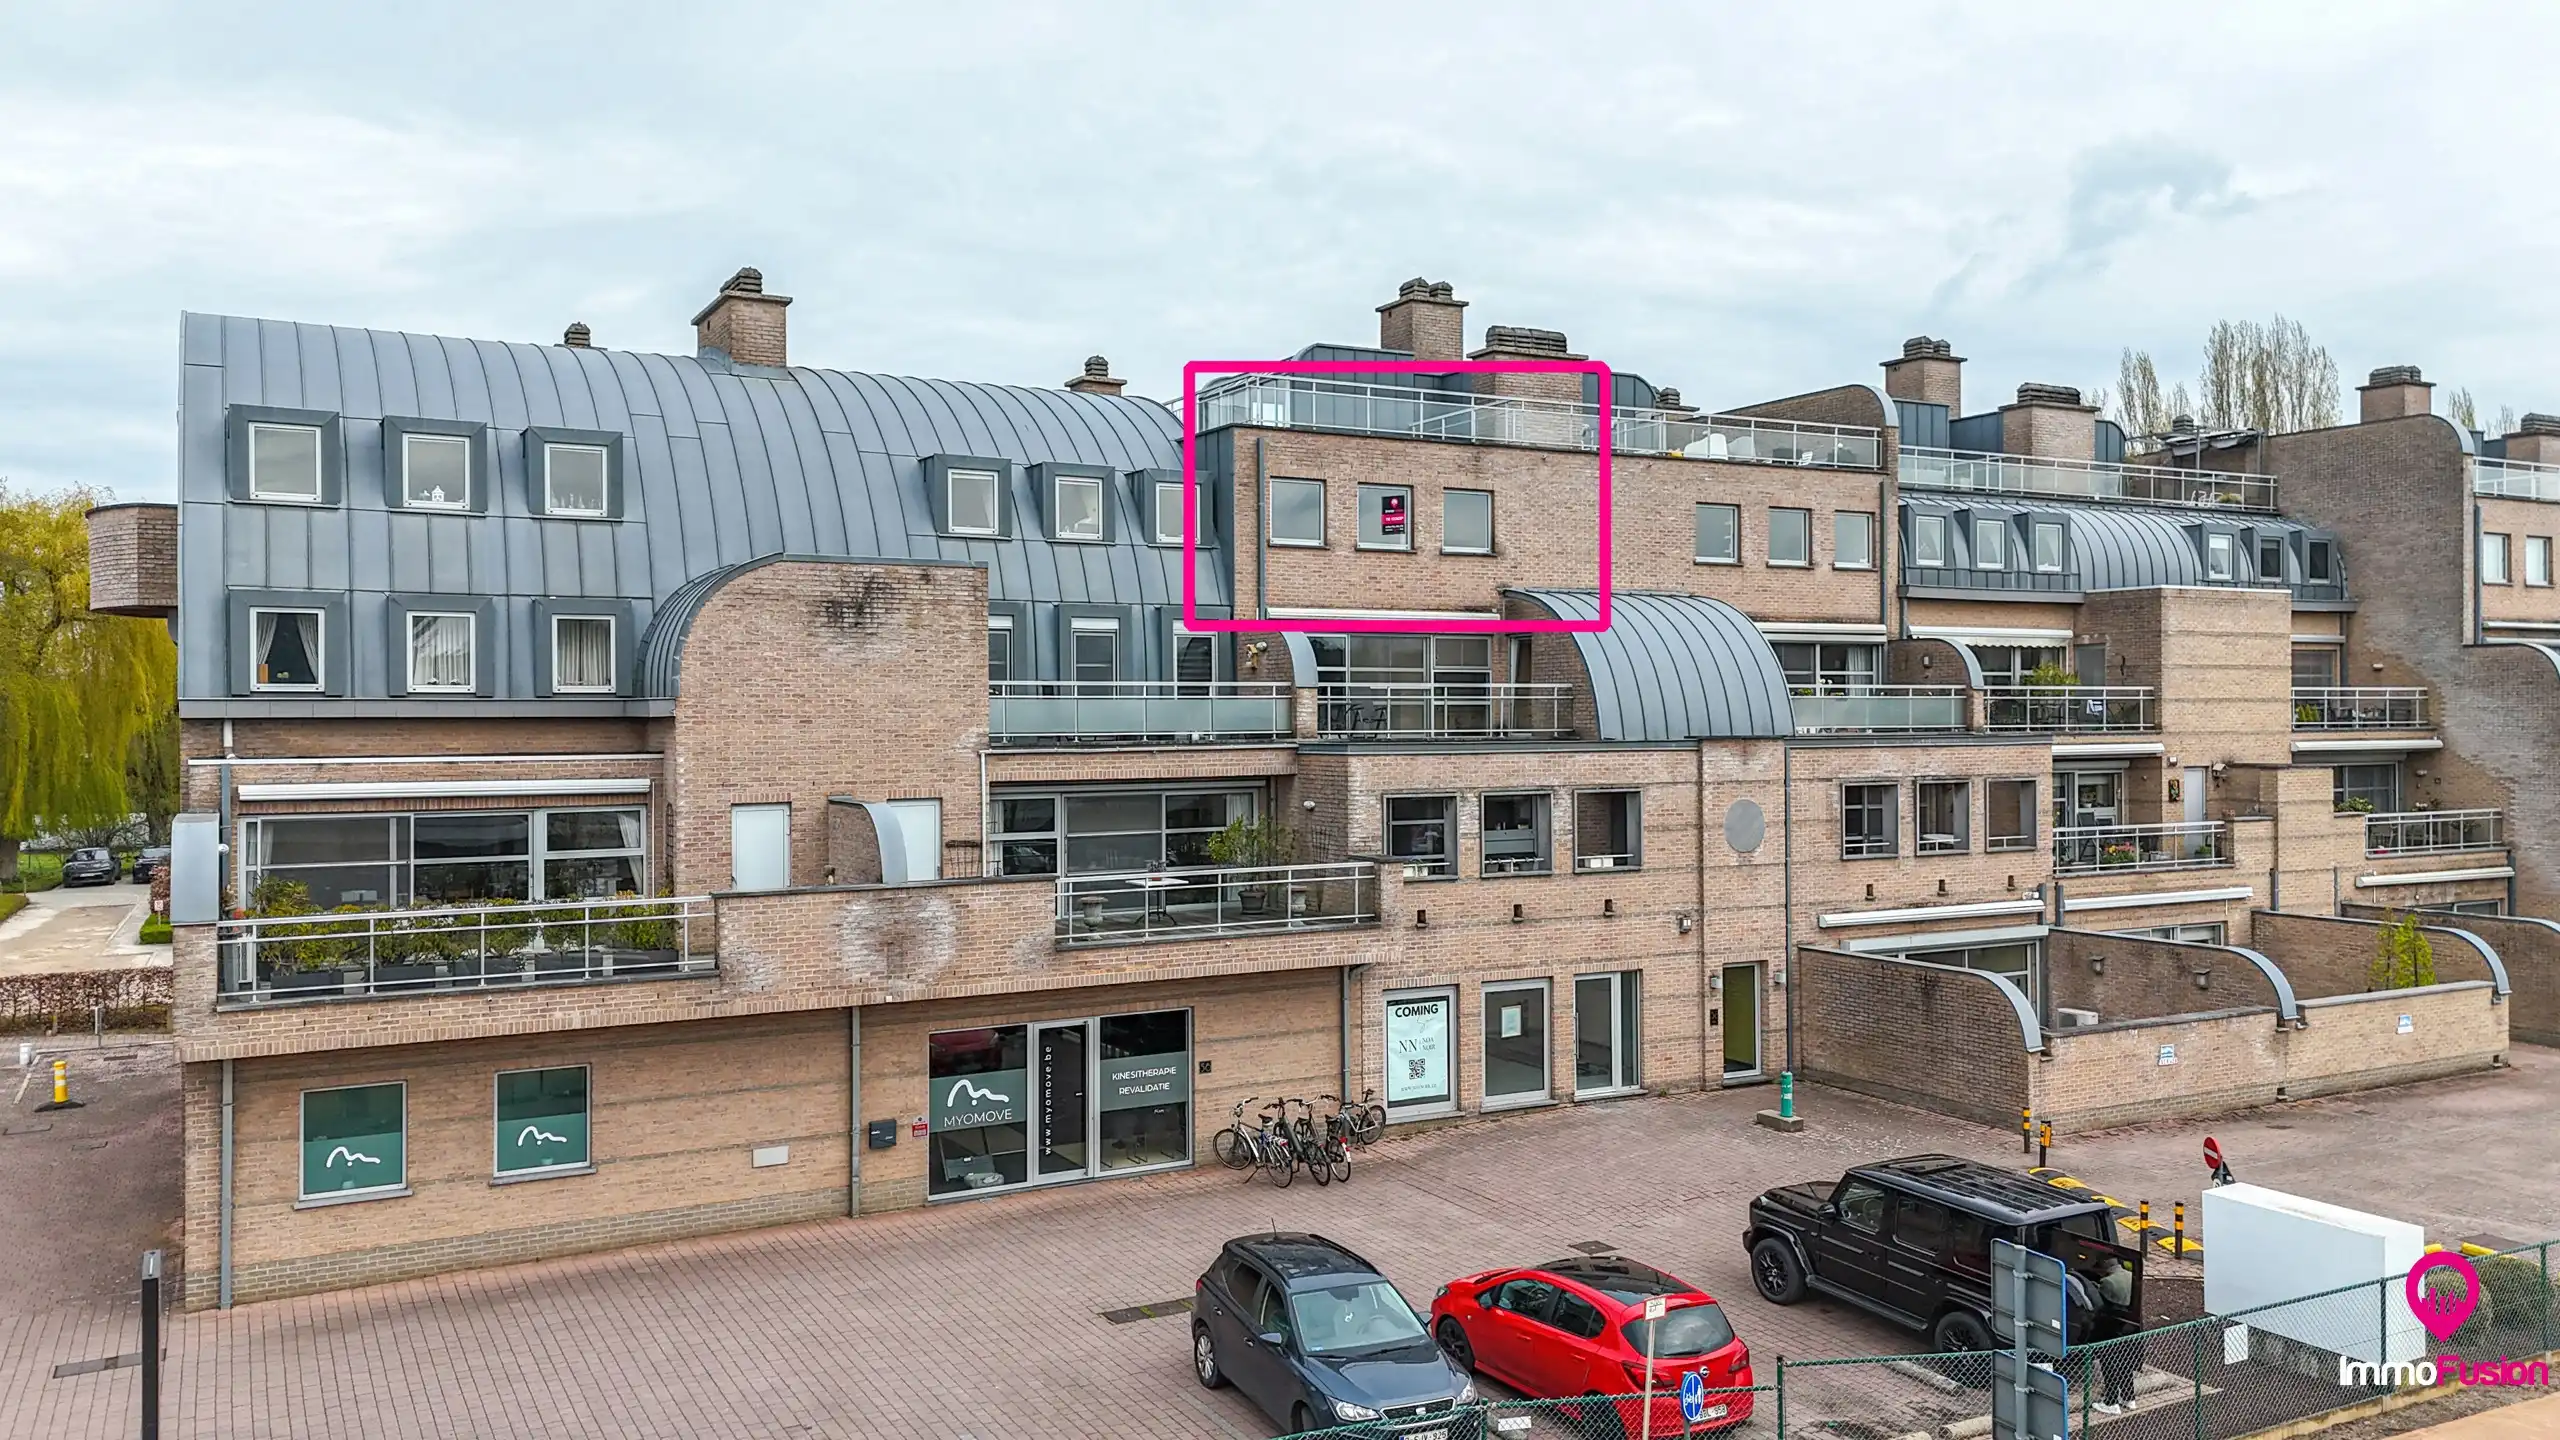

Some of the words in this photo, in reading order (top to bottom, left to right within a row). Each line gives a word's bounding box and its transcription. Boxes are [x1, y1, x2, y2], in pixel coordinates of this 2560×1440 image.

[1395, 1004, 1439, 1017] COMING
[1399, 1038, 1417, 1053] NN
[1111, 1066, 1177, 1081] KINESITHERAPIE
[1118, 1082, 1171, 1096] REVALIDATIE
[1044, 1046, 1053, 1156] www.myomove.be
[943, 1108, 1013, 1128] MYOMOVE
